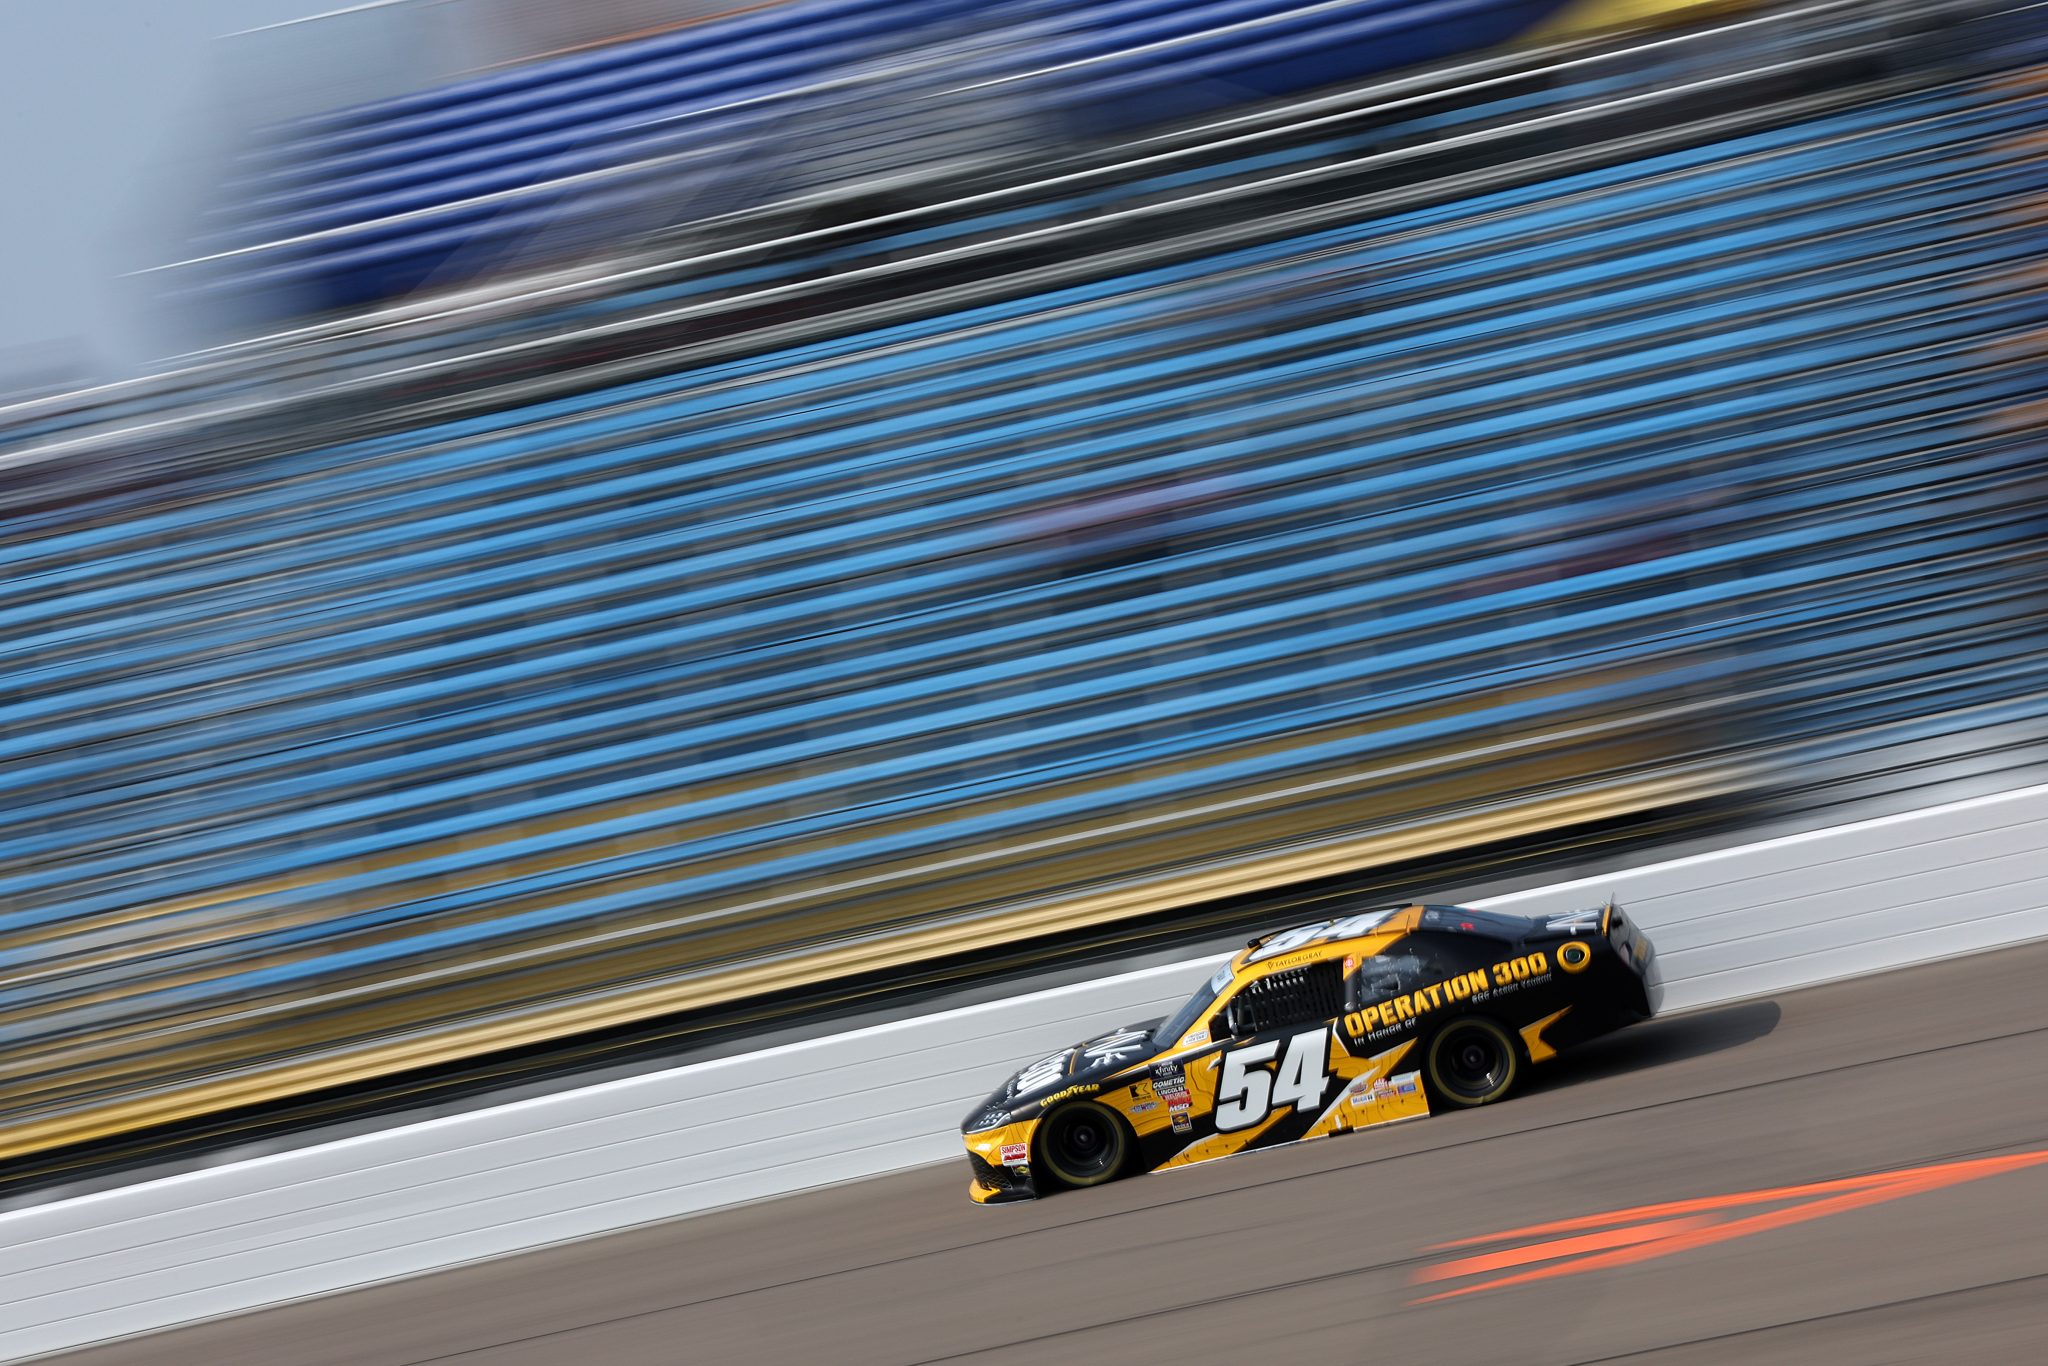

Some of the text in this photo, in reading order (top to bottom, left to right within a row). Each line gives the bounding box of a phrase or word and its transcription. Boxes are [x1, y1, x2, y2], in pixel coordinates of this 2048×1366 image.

[1275, 950, 1323, 968] TAYLOR GRAY
[1343, 952, 1549, 1038] OPERATION 300
[1368, 1023, 1402, 1042] HONOR
[1405, 1016, 1417, 1030] OF
[1155, 1064, 1178, 1075] xfinity
[1215, 1027, 1330, 1132] 54
[1039, 1083, 1100, 1108] GOODYEAR
[1157, 1086, 1184, 1096] LINCOLN
[1001, 1144, 1026, 1154] SIMPSON
